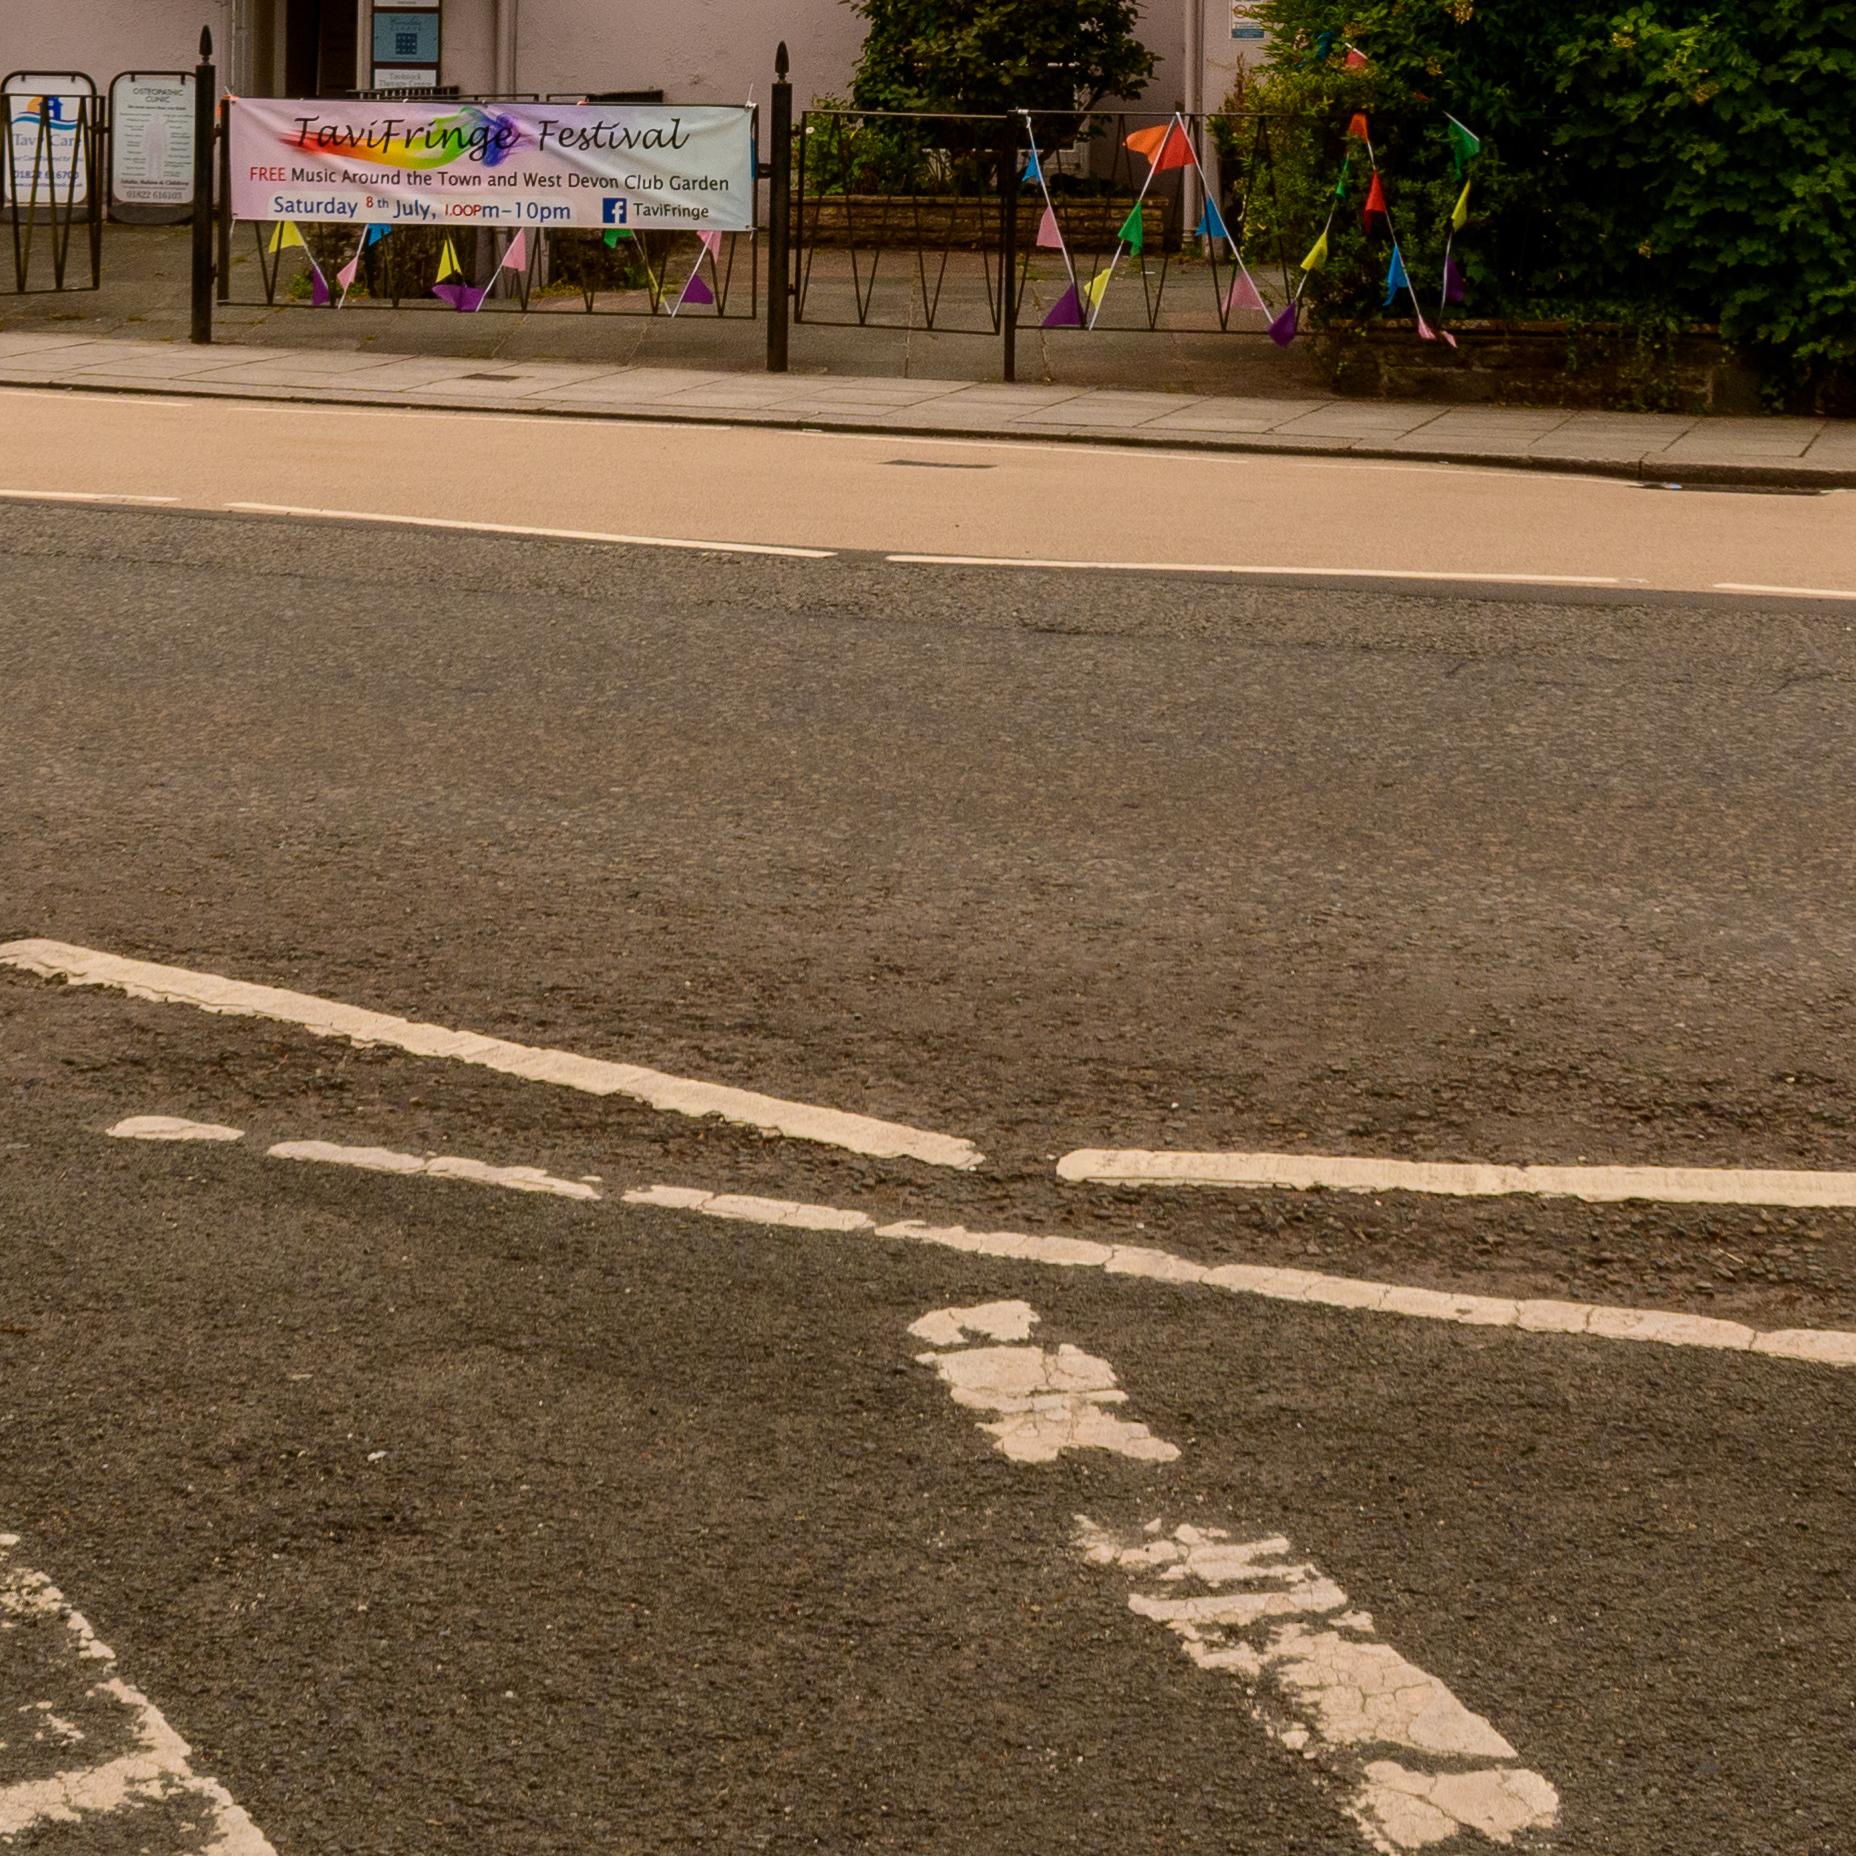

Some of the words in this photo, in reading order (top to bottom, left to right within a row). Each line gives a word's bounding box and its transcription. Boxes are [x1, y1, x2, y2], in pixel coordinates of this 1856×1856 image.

[294, 115, 521, 162] TaviFringe
[538, 117, 690, 152] Festival
[249, 166, 287, 182] FREE
[291, 167, 337, 184] Music
[341, 169, 401, 186] Around
[406, 169, 432, 186] the
[437, 171, 482, 187] Town
[487, 172, 518, 187] and
[523, 172, 561, 188] West
[568, 173, 619, 189] Devon
[624, 174, 664, 190] Club
[669, 175, 729, 191] Garden
[273, 195, 358, 218] Saturday
[393, 199, 437, 220] July,
[633, 202, 710, 221] TaviFringe
